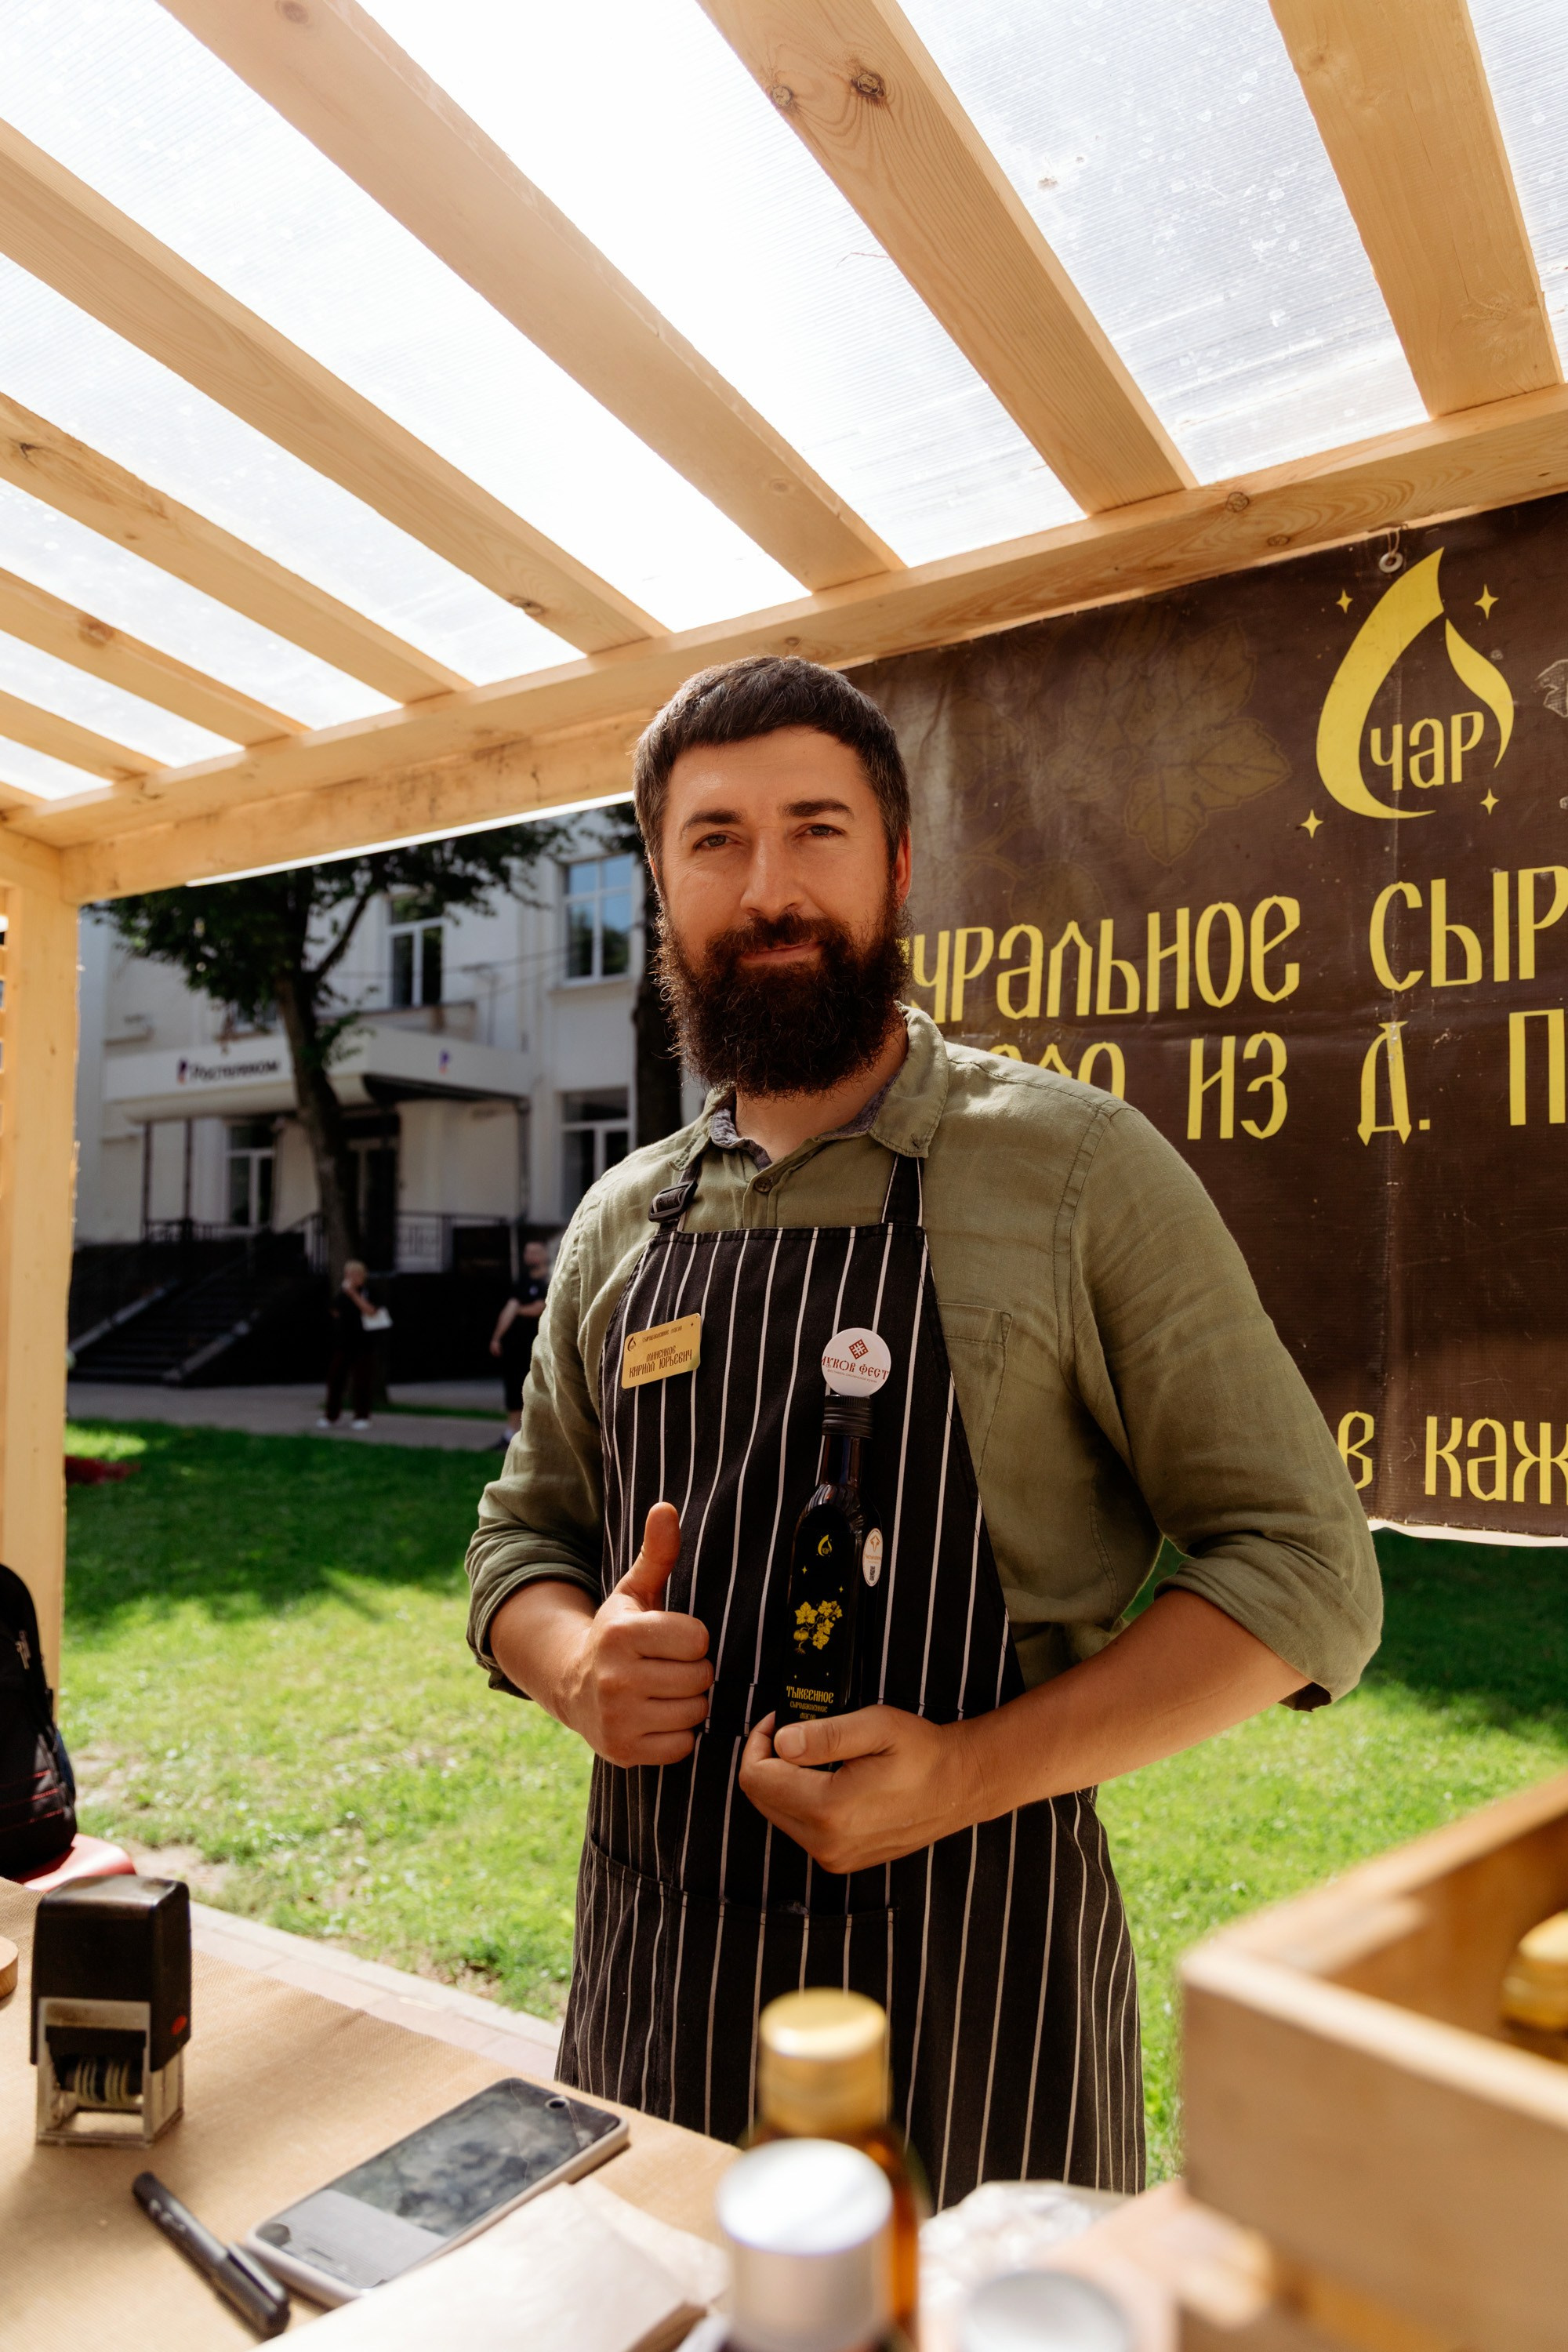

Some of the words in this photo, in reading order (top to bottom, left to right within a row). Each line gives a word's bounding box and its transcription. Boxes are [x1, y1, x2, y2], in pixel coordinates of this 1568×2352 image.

[897, 895, 1301, 1025] УРАЛЬНОЕ
[1187, 1031, 1287, 1140] ИЗ
[1357, 1021, 1431, 1146] Д.
[1509, 1008, 1566, 1126] П
[629, 1361, 655, 1378] КИРИЛЛ
[659, 1348, 692, 1370] ЮРЬЕВИЧ
[786, 1686, 834, 1704] ТЫКВЕННОЕ
